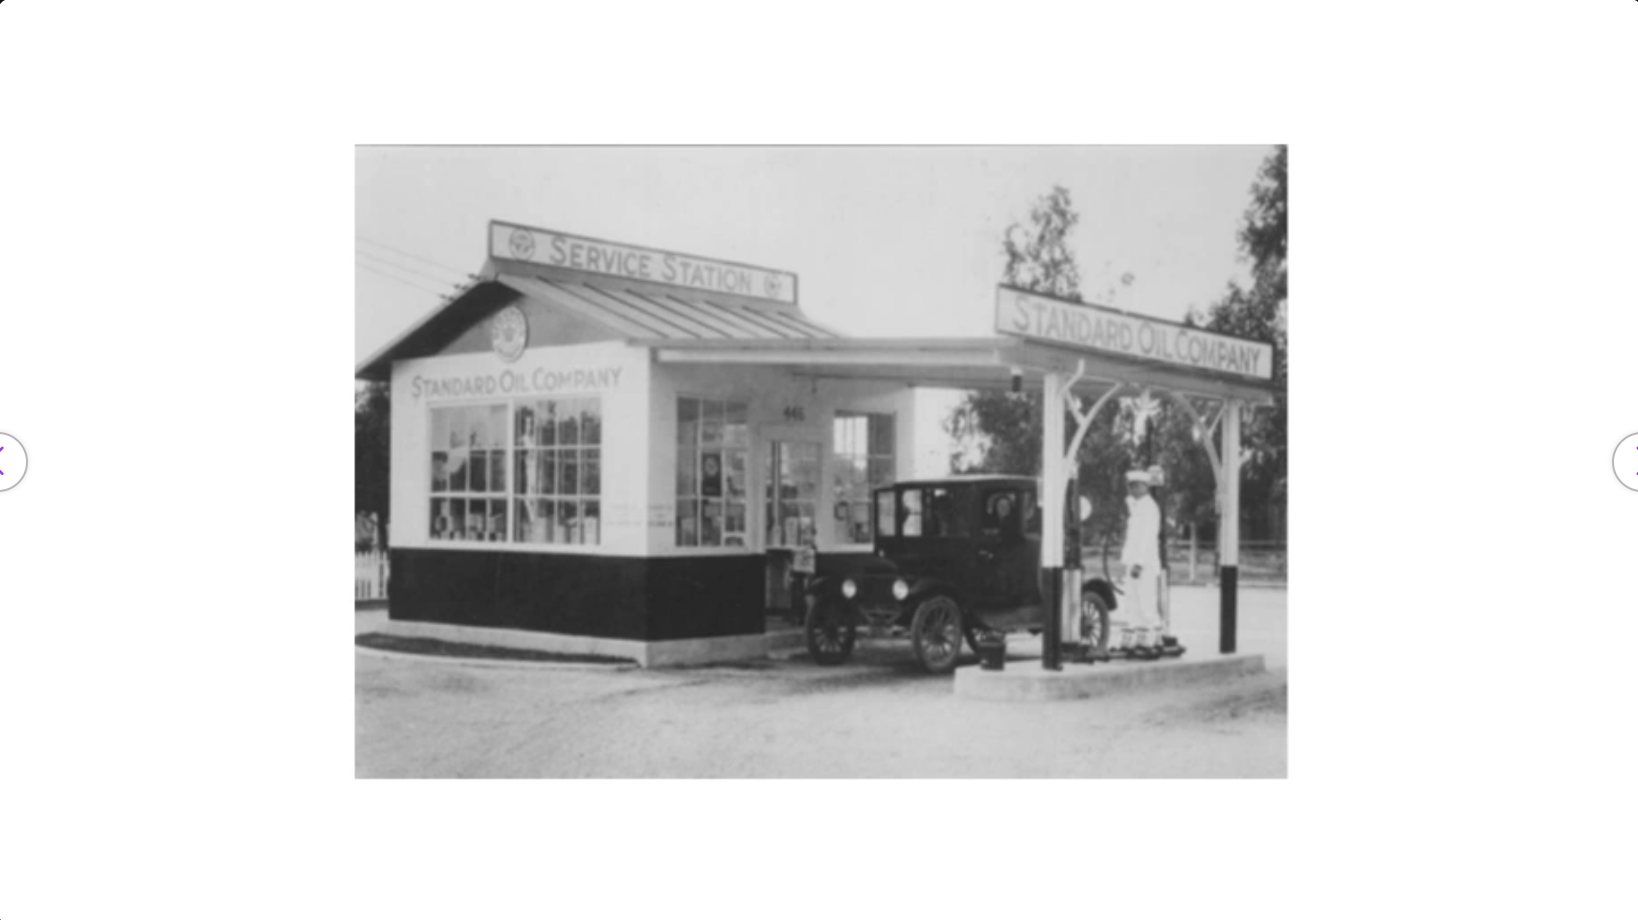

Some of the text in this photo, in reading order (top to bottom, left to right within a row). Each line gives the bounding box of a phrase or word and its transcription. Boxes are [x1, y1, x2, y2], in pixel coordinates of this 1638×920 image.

[550, 236, 752, 293] SERVICE STATION
[1012, 294, 1262, 375] STANDARD OIL COMPANY
[411, 366, 622, 399] STANDARD OIL COMPANY
